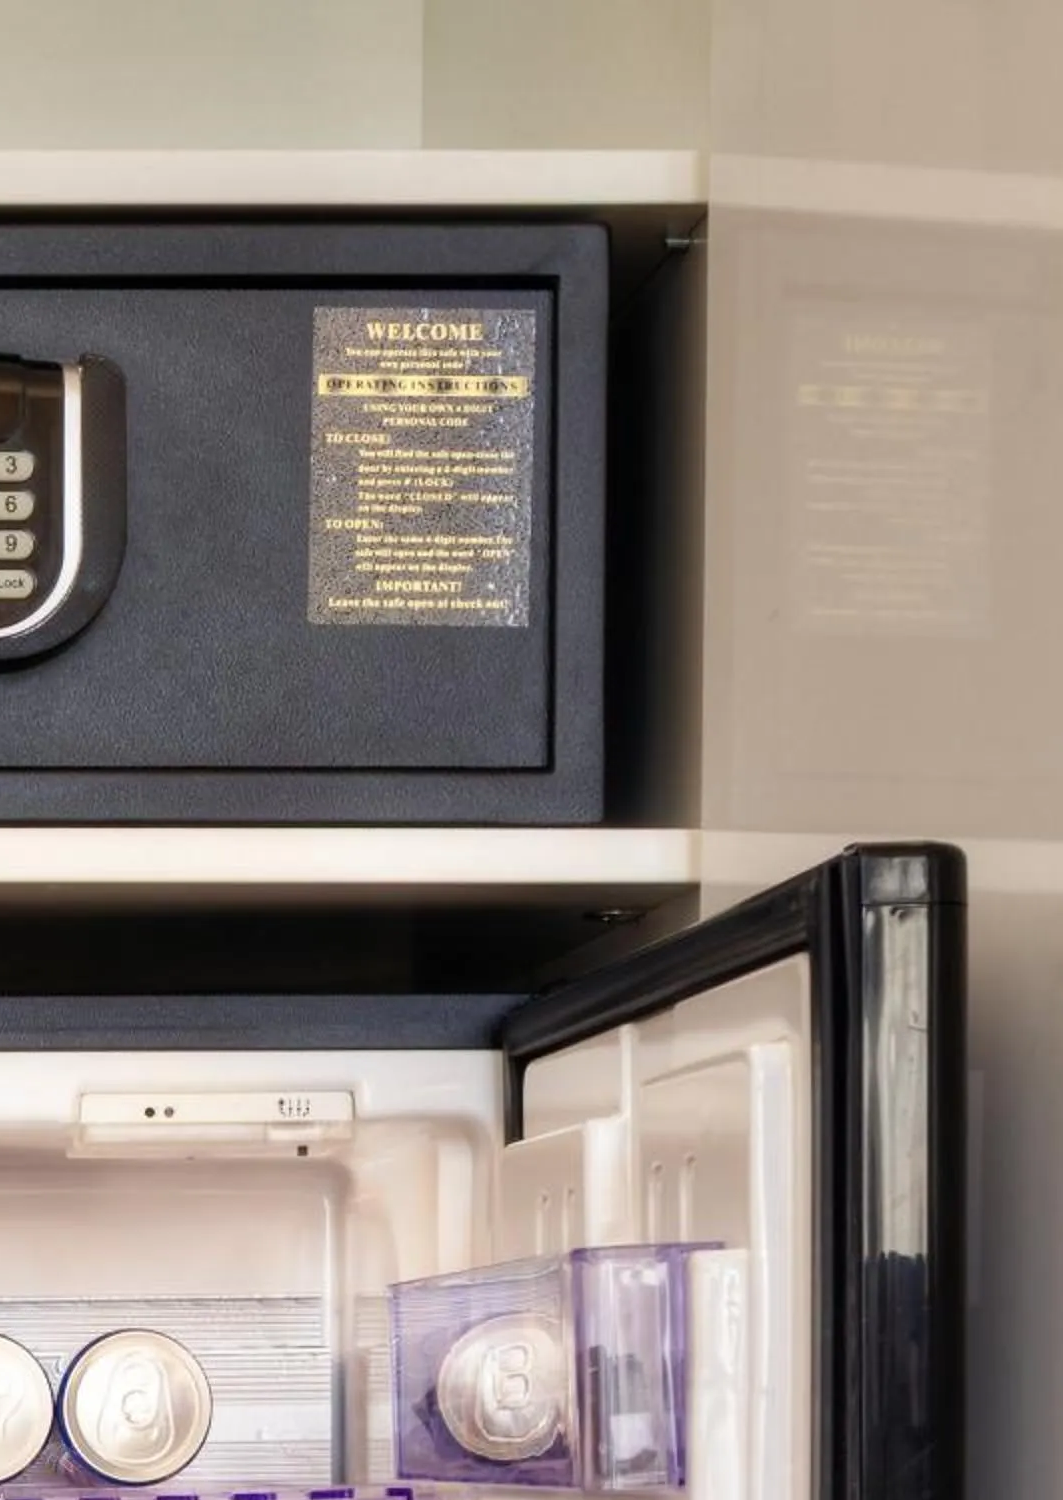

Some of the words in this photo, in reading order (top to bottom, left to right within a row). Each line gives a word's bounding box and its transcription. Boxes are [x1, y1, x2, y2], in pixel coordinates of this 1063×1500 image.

[366, 322, 483, 341] WELCOME
[326, 378, 407, 390] OPERATING
[412, 379, 518, 390] INSTRUCTIONS
[325, 433, 343, 443] TO
[5, 457, 17, 473] 3
[5, 495, 17, 512] 6
[325, 519, 342, 529] TO
[5, 535, 17, 551] 9
[376, 580, 462, 592] IMPORTANT!
